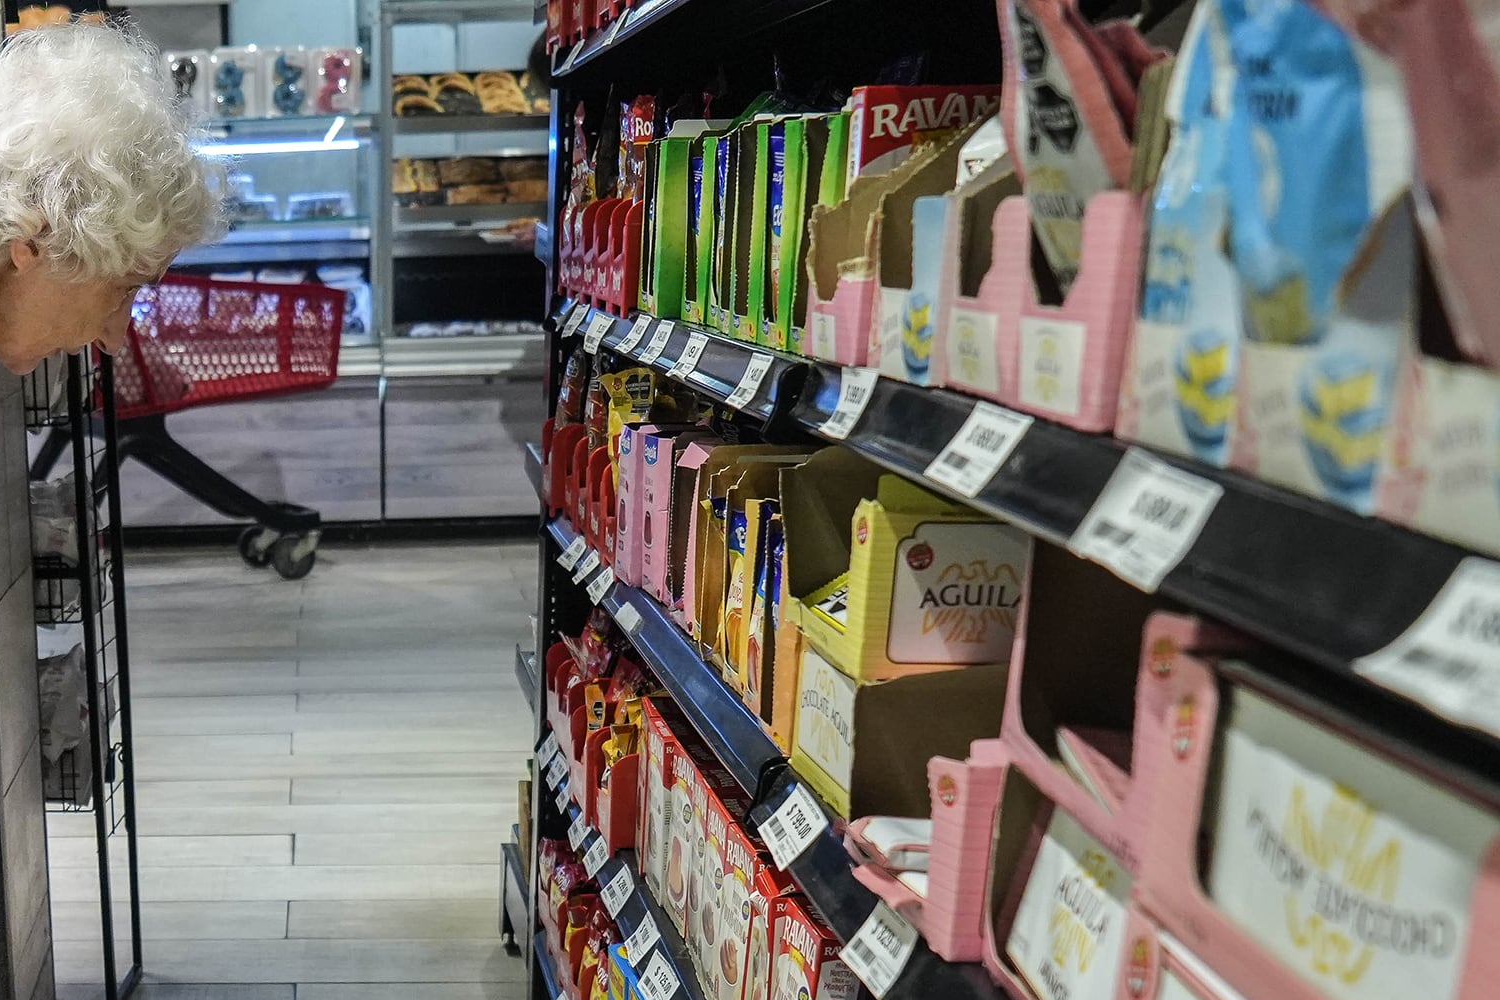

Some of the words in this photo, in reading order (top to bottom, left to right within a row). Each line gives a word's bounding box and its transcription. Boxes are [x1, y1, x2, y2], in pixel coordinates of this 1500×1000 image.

[869, 92, 1000, 138] RAVAN
[792, 811, 812, 840] 799.00
[726, 839, 755, 887] RAVANA
[782, 915, 818, 972] RAVANA
[658, 970, 673, 994] 125.00
